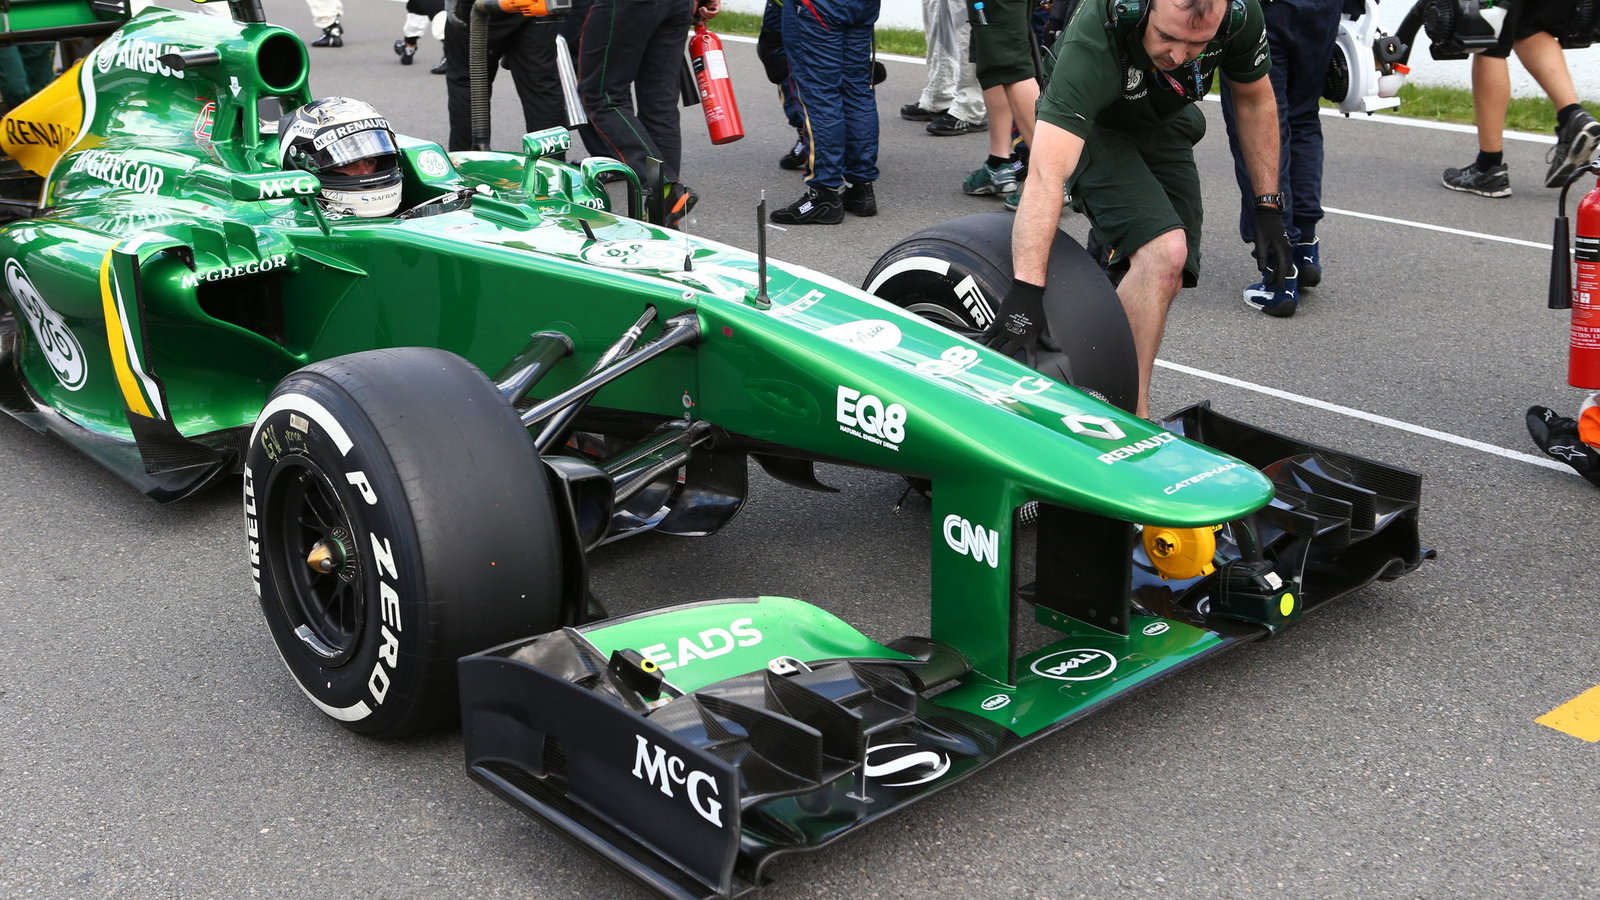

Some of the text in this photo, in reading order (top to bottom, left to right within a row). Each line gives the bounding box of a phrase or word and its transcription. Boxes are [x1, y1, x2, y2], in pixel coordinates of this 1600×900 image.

[336, 119, 392, 138] RENAULT
[538, 134, 571, 155] McG
[258, 176, 315, 200] McG
[181, 254, 287, 288] McGREGOR
[836, 385, 908, 445] EQ8
[839, 425, 900, 452] NATURAL ENERGY DRINK
[1097, 431, 1179, 466] RENAULT
[1163, 462, 1243, 495] CATERHAM
[943, 513, 999, 569] CNN
[346, 470, 402, 705] P ZERO
[639, 618, 764, 672] EADS
[1045, 652, 1102, 676] DELL
[631, 733, 724, 829] McG
